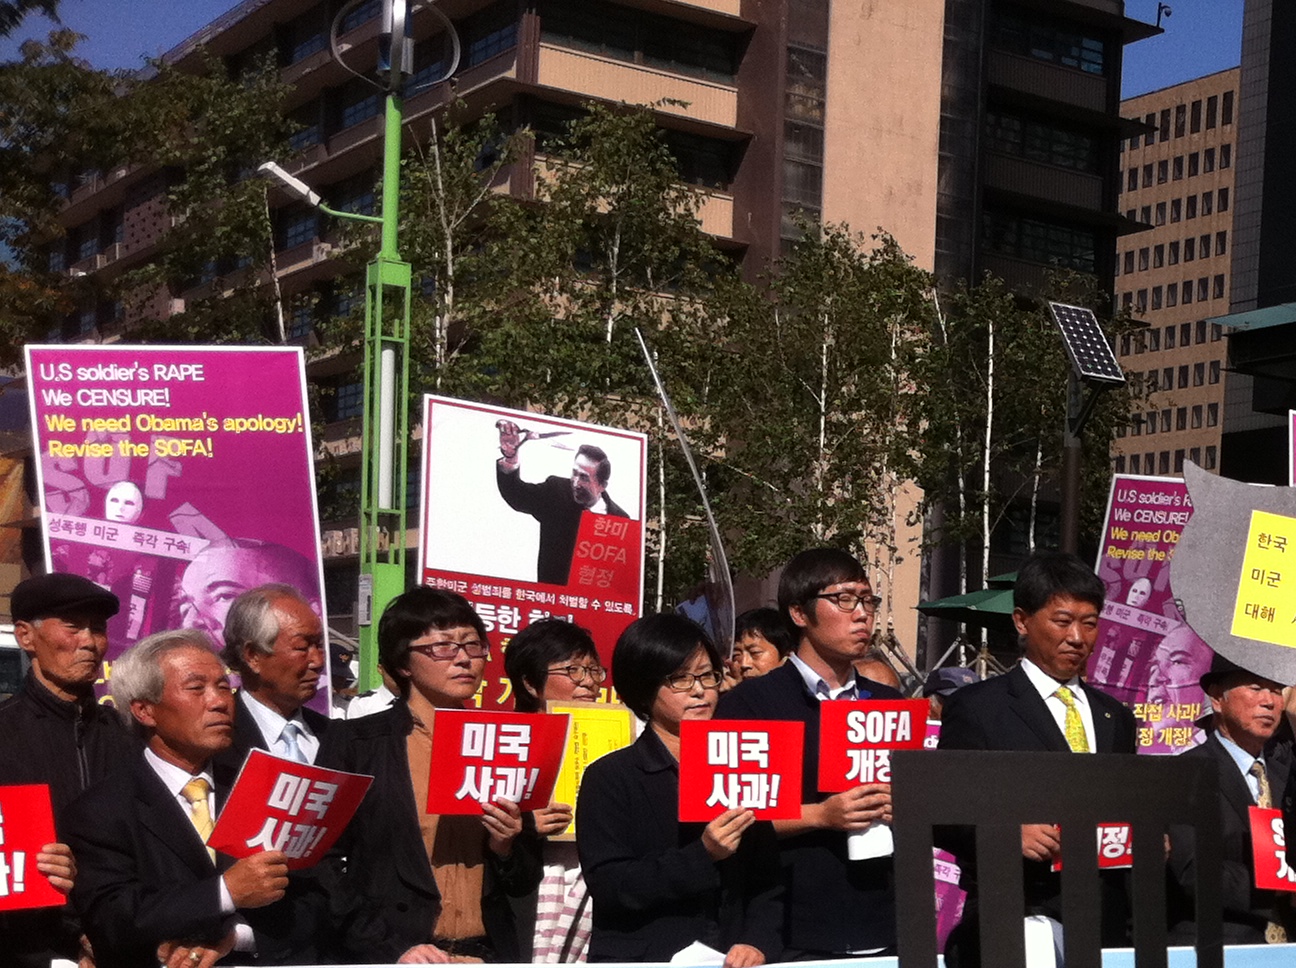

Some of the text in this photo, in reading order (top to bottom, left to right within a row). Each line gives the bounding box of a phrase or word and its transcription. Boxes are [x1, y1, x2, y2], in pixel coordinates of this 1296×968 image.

[40, 362, 204, 381] U.S soldier's RAPE
[41, 388, 170, 407] We CENSURE!
[45, 412, 303, 433] We need Obama's apology!
[48, 438, 213, 458] Revise the SOFA!
[1138, 491, 1181, 506] soldier's
[1114, 508, 1189, 525] We CENSURE!
[49, 518, 87, 537] 성폭행
[93, 526, 119, 541] 미군
[594, 517, 629, 541] 한미
[1111, 527, 1129, 540] We
[1131, 530, 1160, 542] need
[576, 541, 627, 564] SOFA
[1257, 532, 1288, 553] 한국
[1107, 546, 1145, 560] Revise
[1148, 549, 1165, 561] the
[579, 565, 614, 588] 협정
[1251, 568, 1281, 588] 미군
[515, 588, 556, 605] 한국에서
[591, 600, 601, 611] 수
[1245, 603, 1276, 623] 대해
[1133, 704, 1200, 721] 직접 사과!
[846, 710, 912, 744] SOFA
[1158, 727, 1192, 746] 개정!
[460, 723, 531, 762] 미국
[707, 732, 769, 768] 미국
[454, 766, 539, 803] 사과!
[706, 773, 781, 810] 사과!
[266, 772, 339, 819] 미국
[246, 818, 327, 860] 사과!
